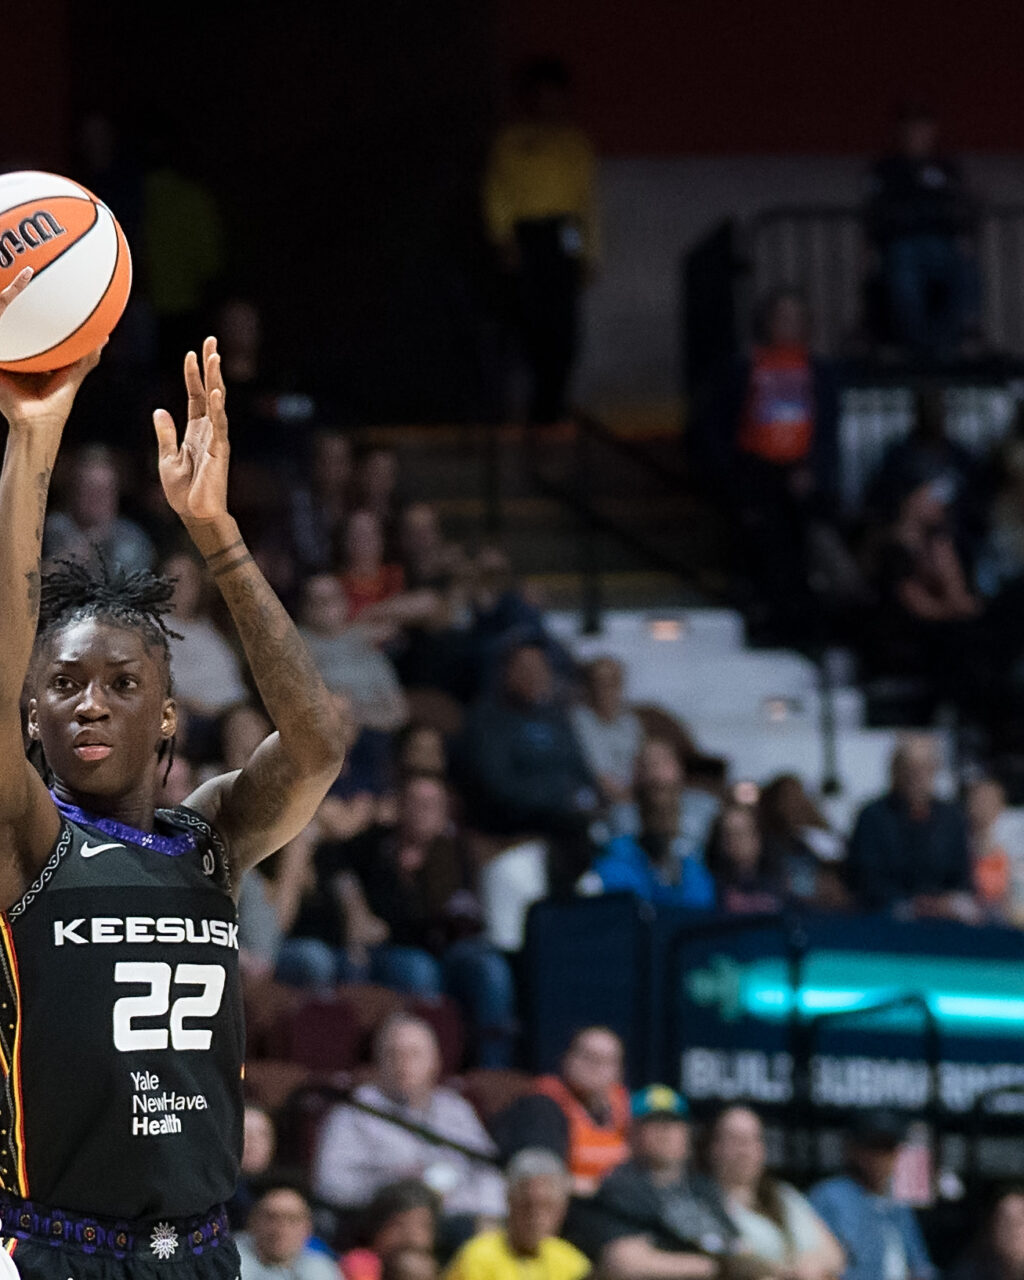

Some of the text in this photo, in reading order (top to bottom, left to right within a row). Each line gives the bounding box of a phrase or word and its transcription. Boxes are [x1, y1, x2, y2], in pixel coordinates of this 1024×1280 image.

[53, 916, 240, 950] KEESUSK
[112, 961, 226, 1052] 22
[130, 1070, 160, 1091] Yale
[132, 1113, 182, 1136] Health
